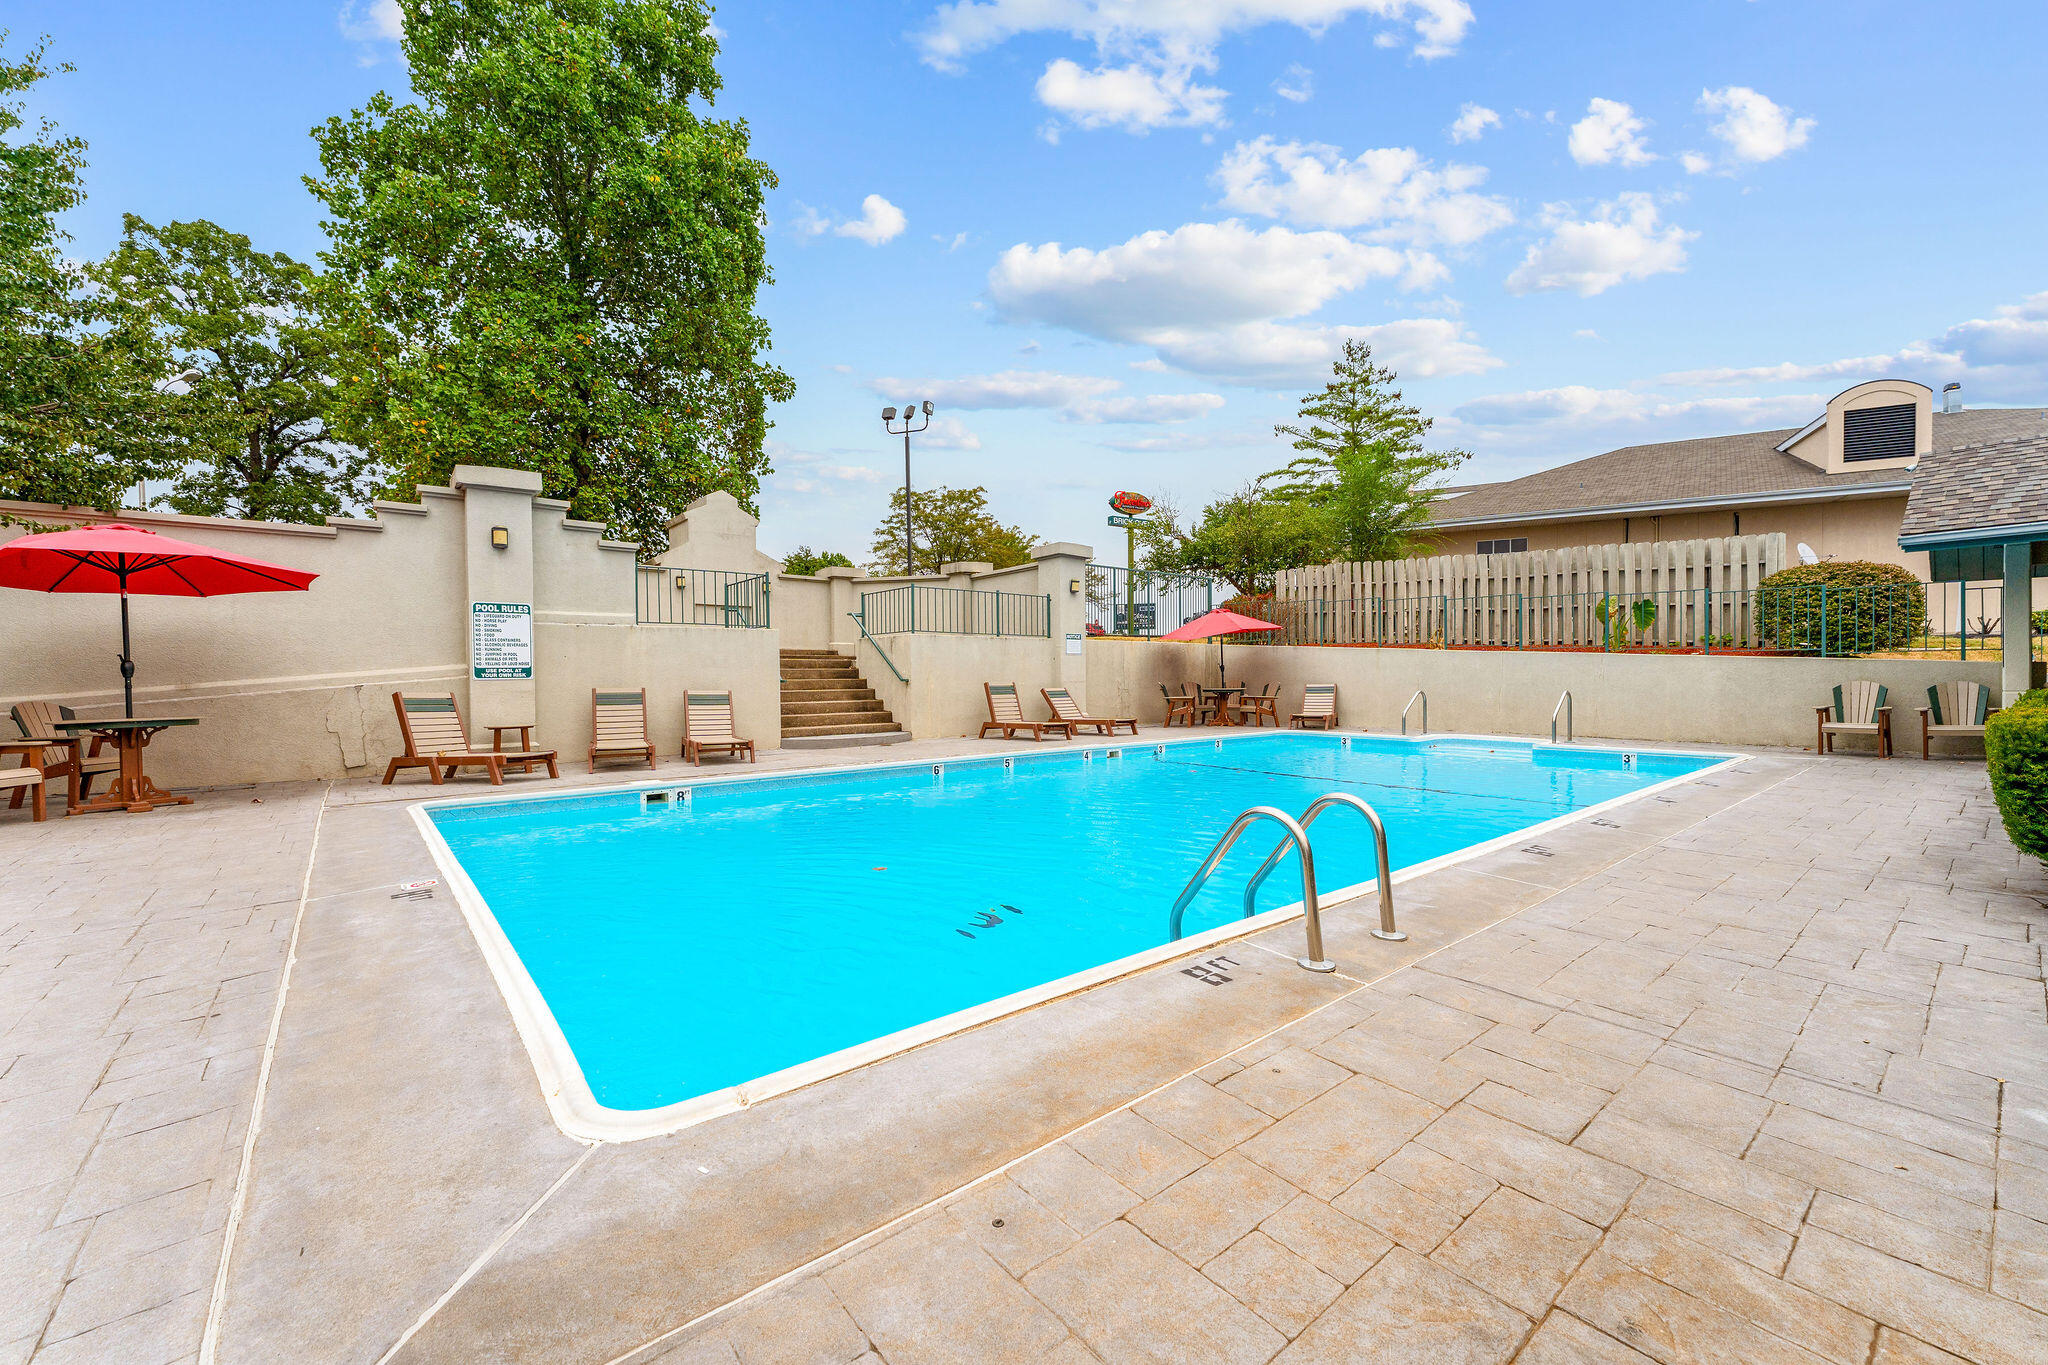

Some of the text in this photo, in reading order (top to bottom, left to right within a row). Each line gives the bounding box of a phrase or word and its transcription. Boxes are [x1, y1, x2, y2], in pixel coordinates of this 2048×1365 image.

[475, 604, 528, 613] POOL RULES
[1624, 754, 1630, 762] 3
[1005, 759, 1010, 768] 5
[934, 766, 939, 775] 6
[677, 791, 684, 802] 8
[1180, 965, 1233, 986] 8
